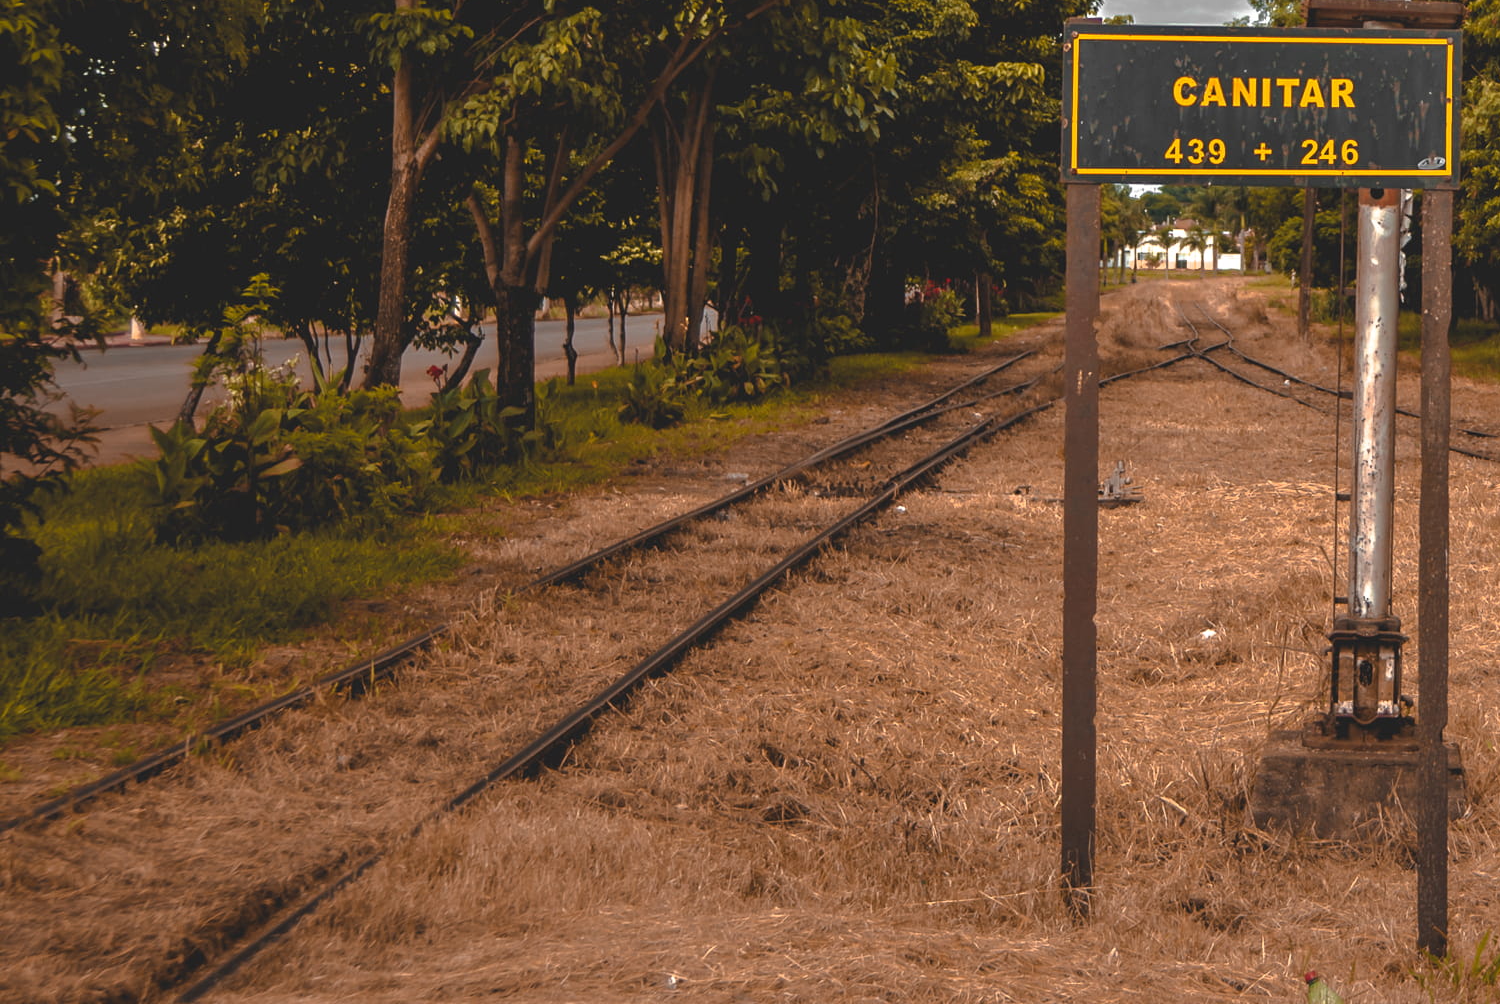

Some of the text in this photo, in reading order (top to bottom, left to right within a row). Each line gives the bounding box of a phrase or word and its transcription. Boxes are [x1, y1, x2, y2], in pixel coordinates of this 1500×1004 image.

[1173, 76, 1356, 108] CANITAR
[1164, 138, 1359, 165] 439 + 246
